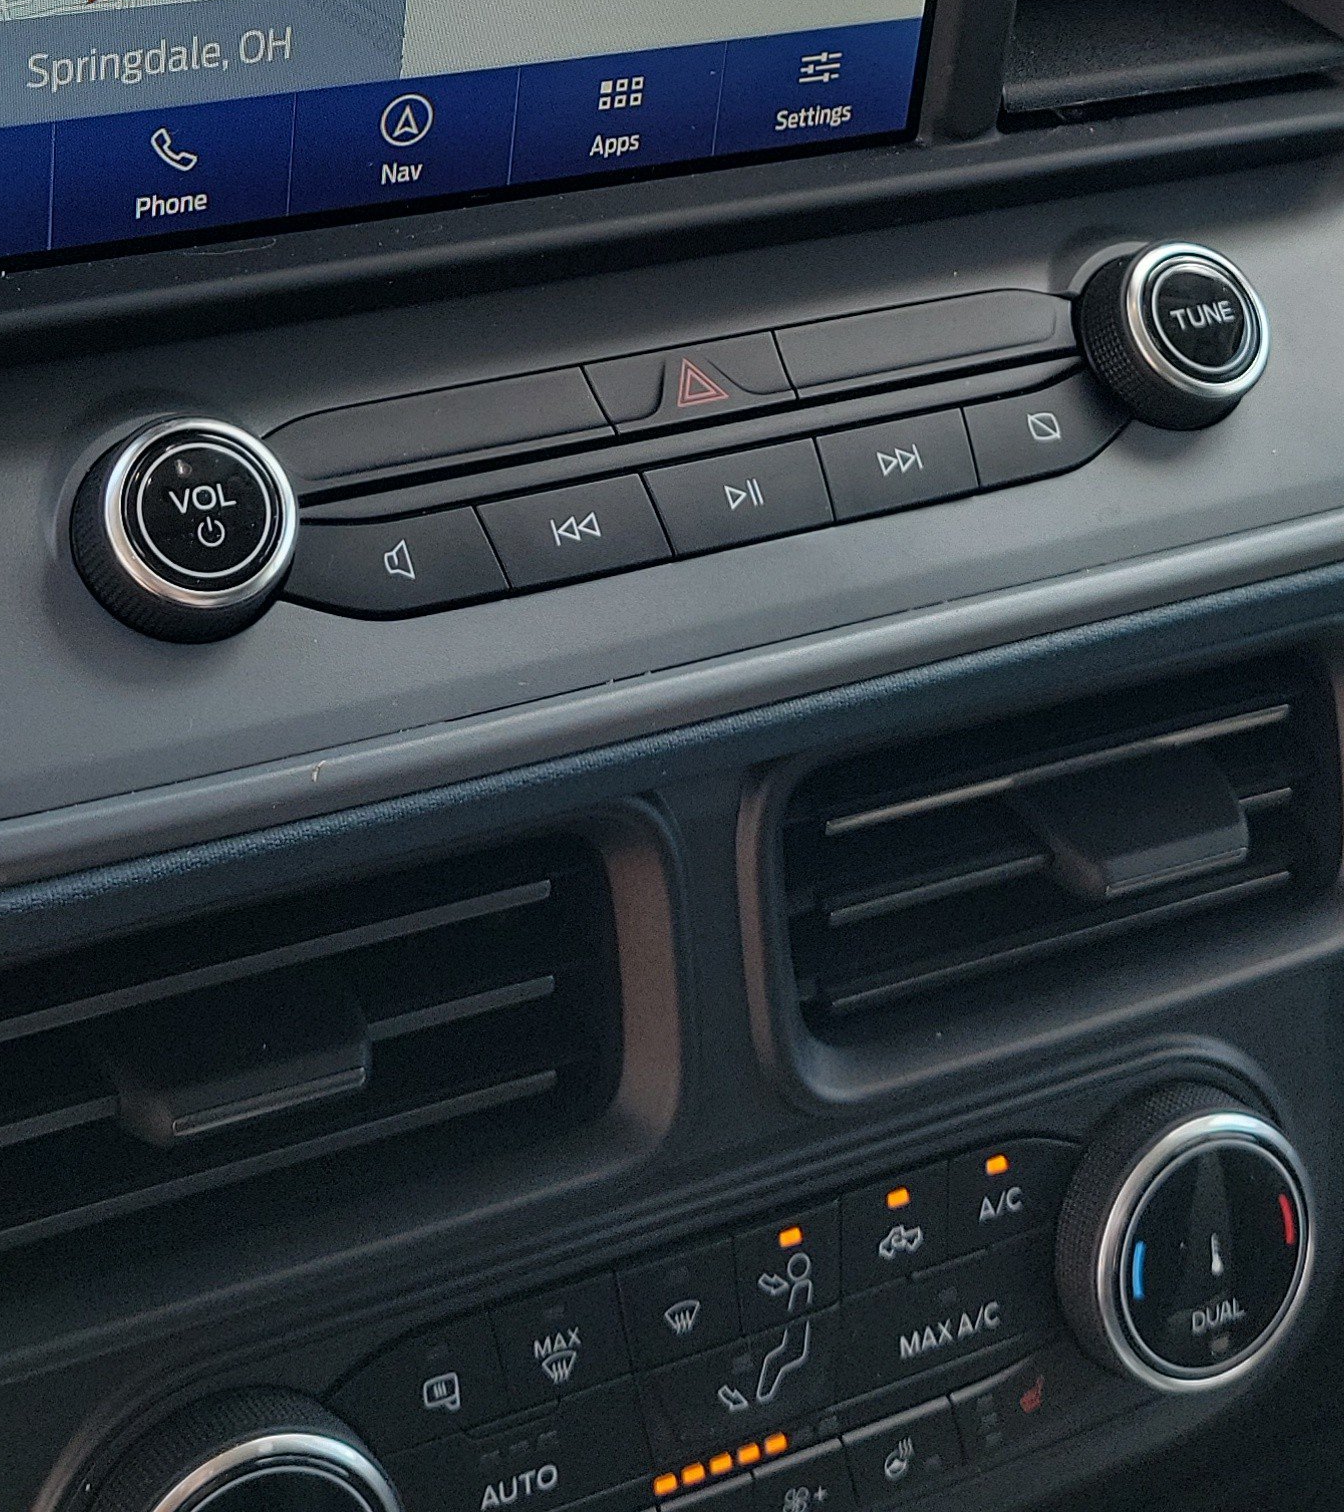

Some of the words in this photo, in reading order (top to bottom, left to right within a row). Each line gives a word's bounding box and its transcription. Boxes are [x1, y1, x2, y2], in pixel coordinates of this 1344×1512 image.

[26, 33, 231, 93] Springdale,
[239, 26, 293, 66] OH
[775, 101, 853, 132] Settings
[589, 133, 641, 160] Apps
[380, 161, 424, 186] Nav
[135, 190, 208, 220] Phone
[1169, 298, 1236, 330] TUNE
[168, 481, 236, 516] VOL
[978, 1185, 1024, 1223] A/C
[897, 1313, 954, 1360] MAX
[956, 1300, 1001, 1337] A/C
[1190, 1295, 1246, 1333] DUAL
[533, 1326, 582, 1359] MAX
[479, 1462, 560, 1512] AUTO
